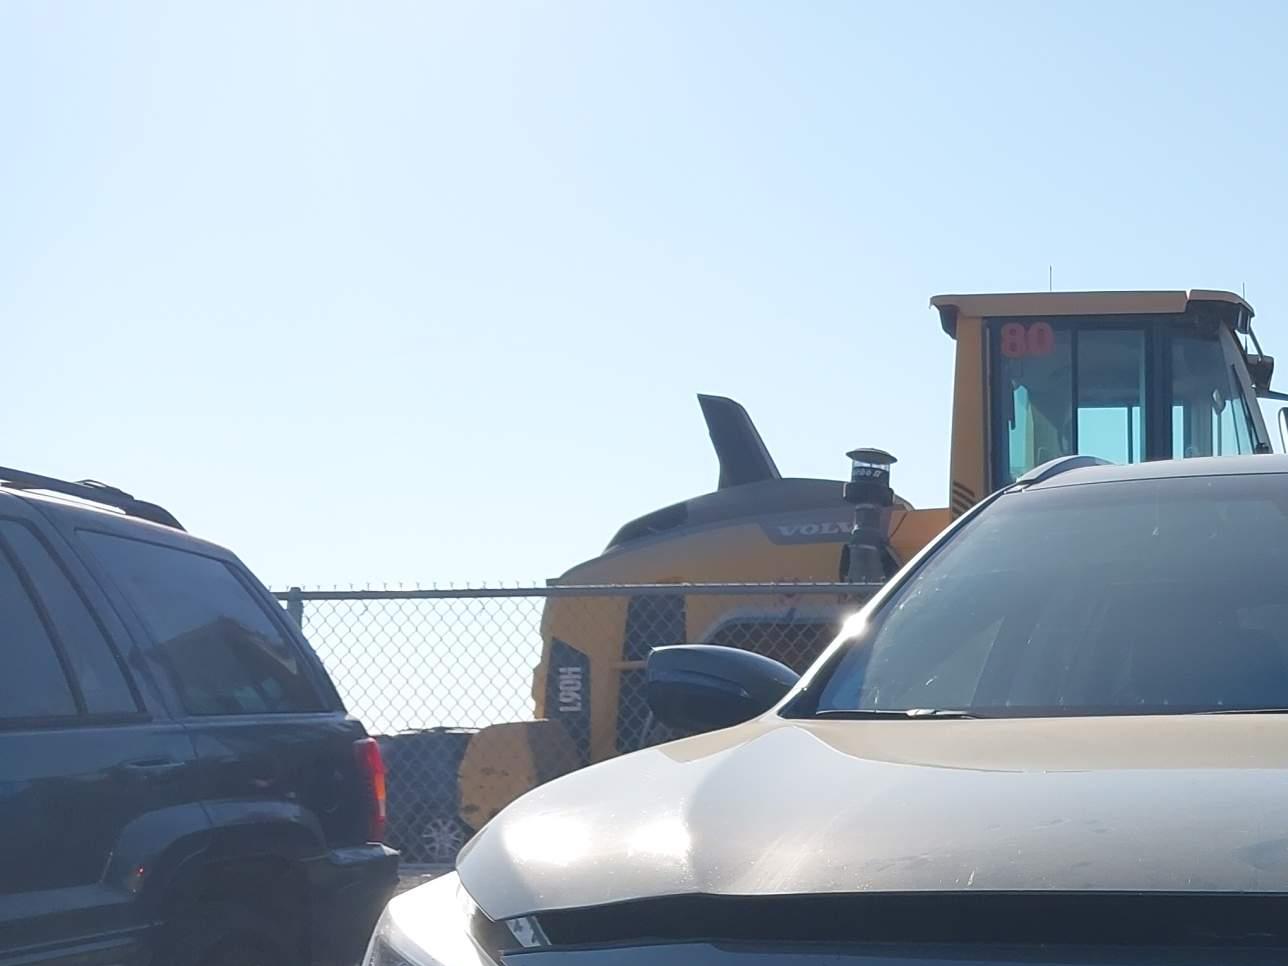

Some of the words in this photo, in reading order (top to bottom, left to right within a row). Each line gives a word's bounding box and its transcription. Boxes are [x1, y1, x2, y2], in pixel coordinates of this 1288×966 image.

[1001, 322, 1057, 357] 80
[778, 521, 853, 536] VOLV
[559, 666, 582, 712] L90H
